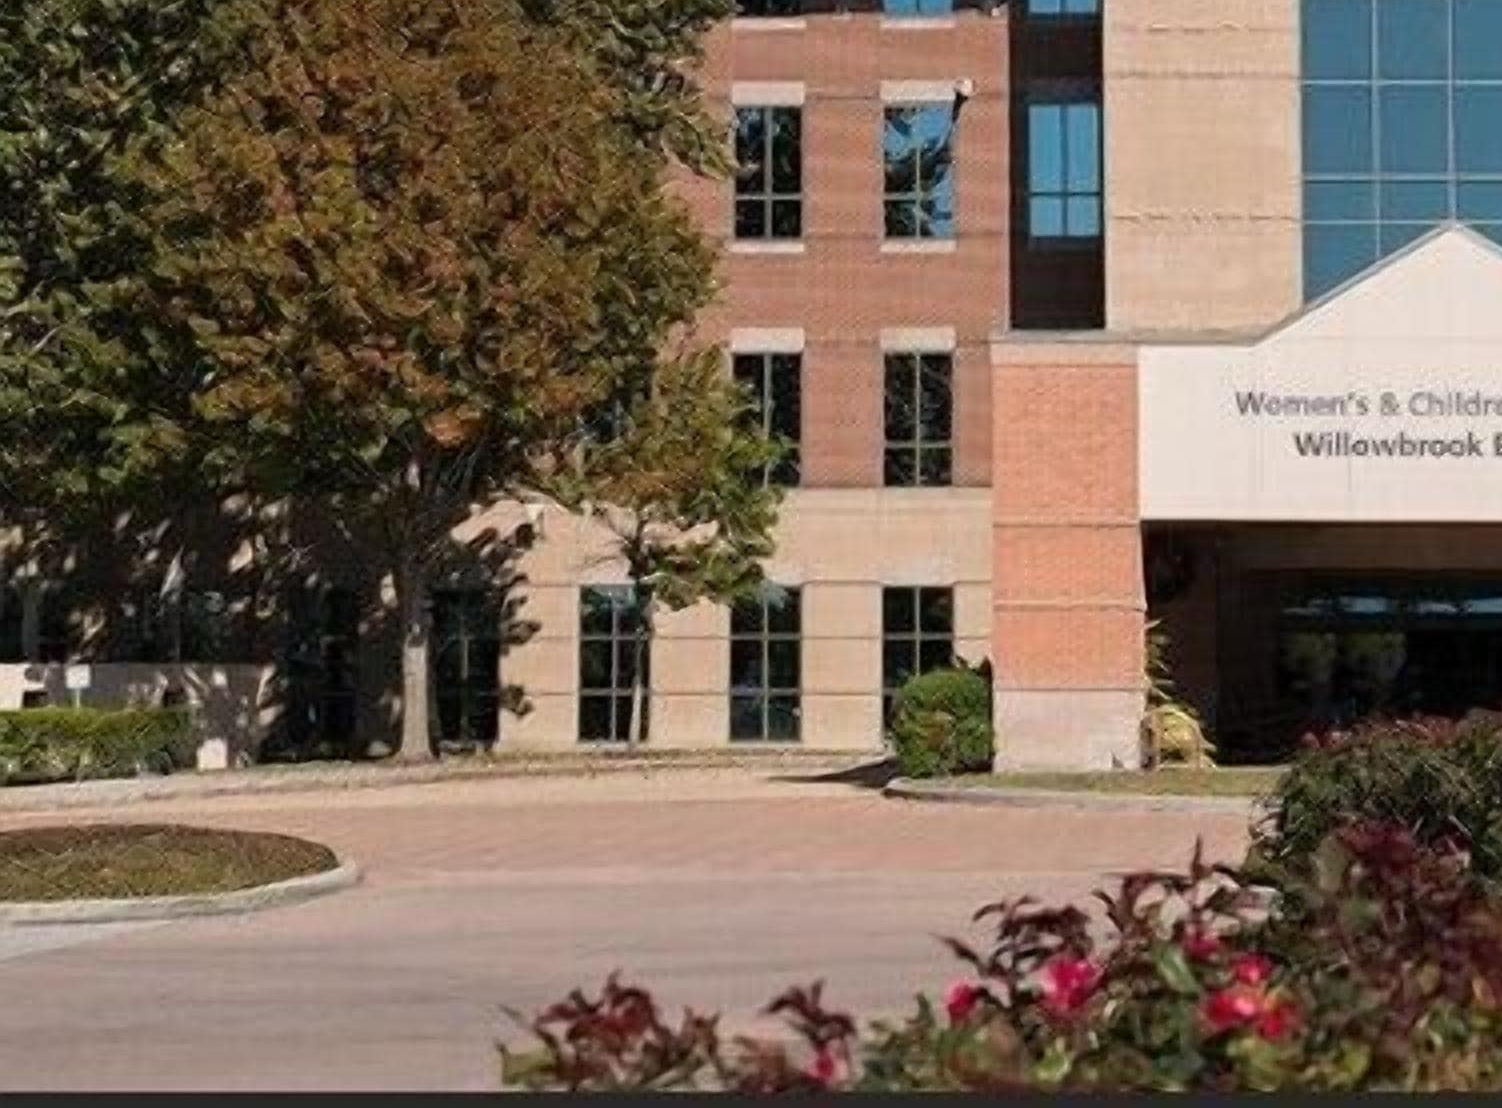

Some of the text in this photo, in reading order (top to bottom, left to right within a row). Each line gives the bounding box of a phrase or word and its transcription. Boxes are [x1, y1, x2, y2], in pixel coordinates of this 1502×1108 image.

[1235, 391, 1369, 417] Women's
[1380, 392, 1400, 417] &
[1294, 432, 1484, 458] Willowbrook
